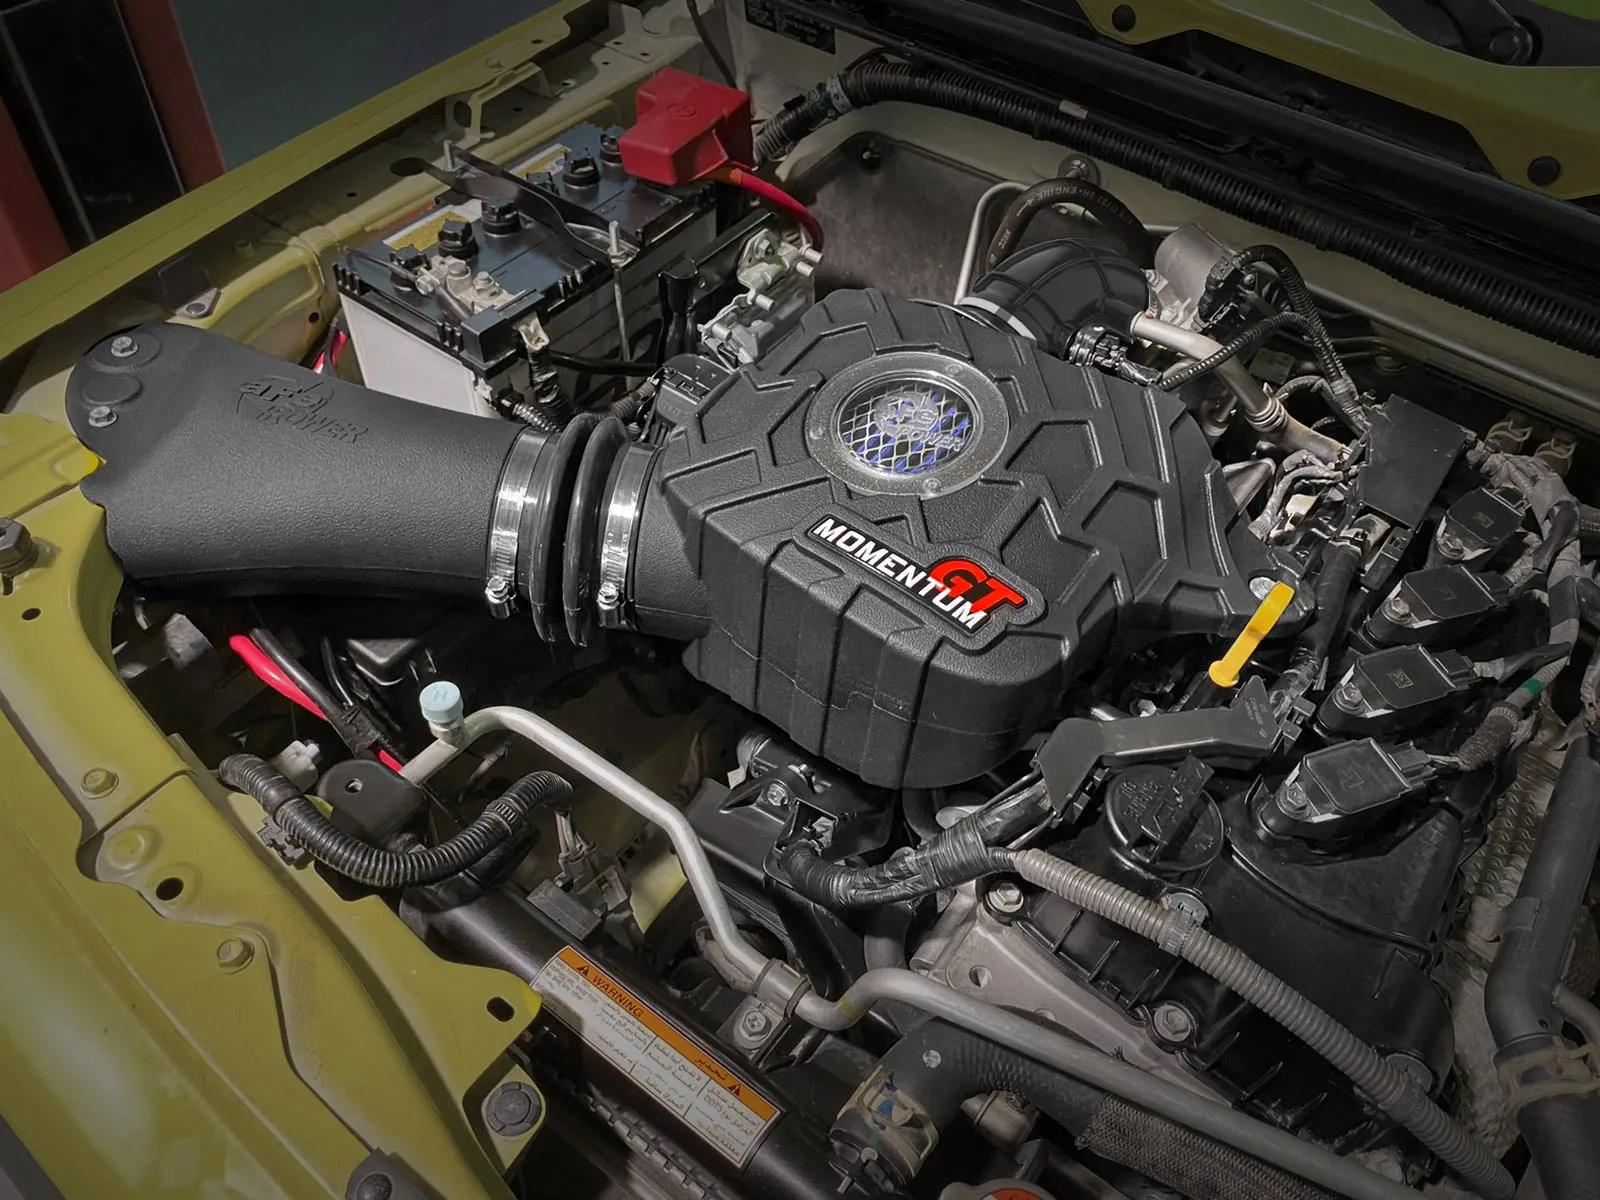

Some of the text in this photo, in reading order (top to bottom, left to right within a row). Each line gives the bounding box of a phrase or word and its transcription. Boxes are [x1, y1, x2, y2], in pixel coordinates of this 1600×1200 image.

[813, 518, 987, 630] MOMENTUM
[928, 559, 1025, 613] GT
[592, 974, 645, 1019] WARNING
